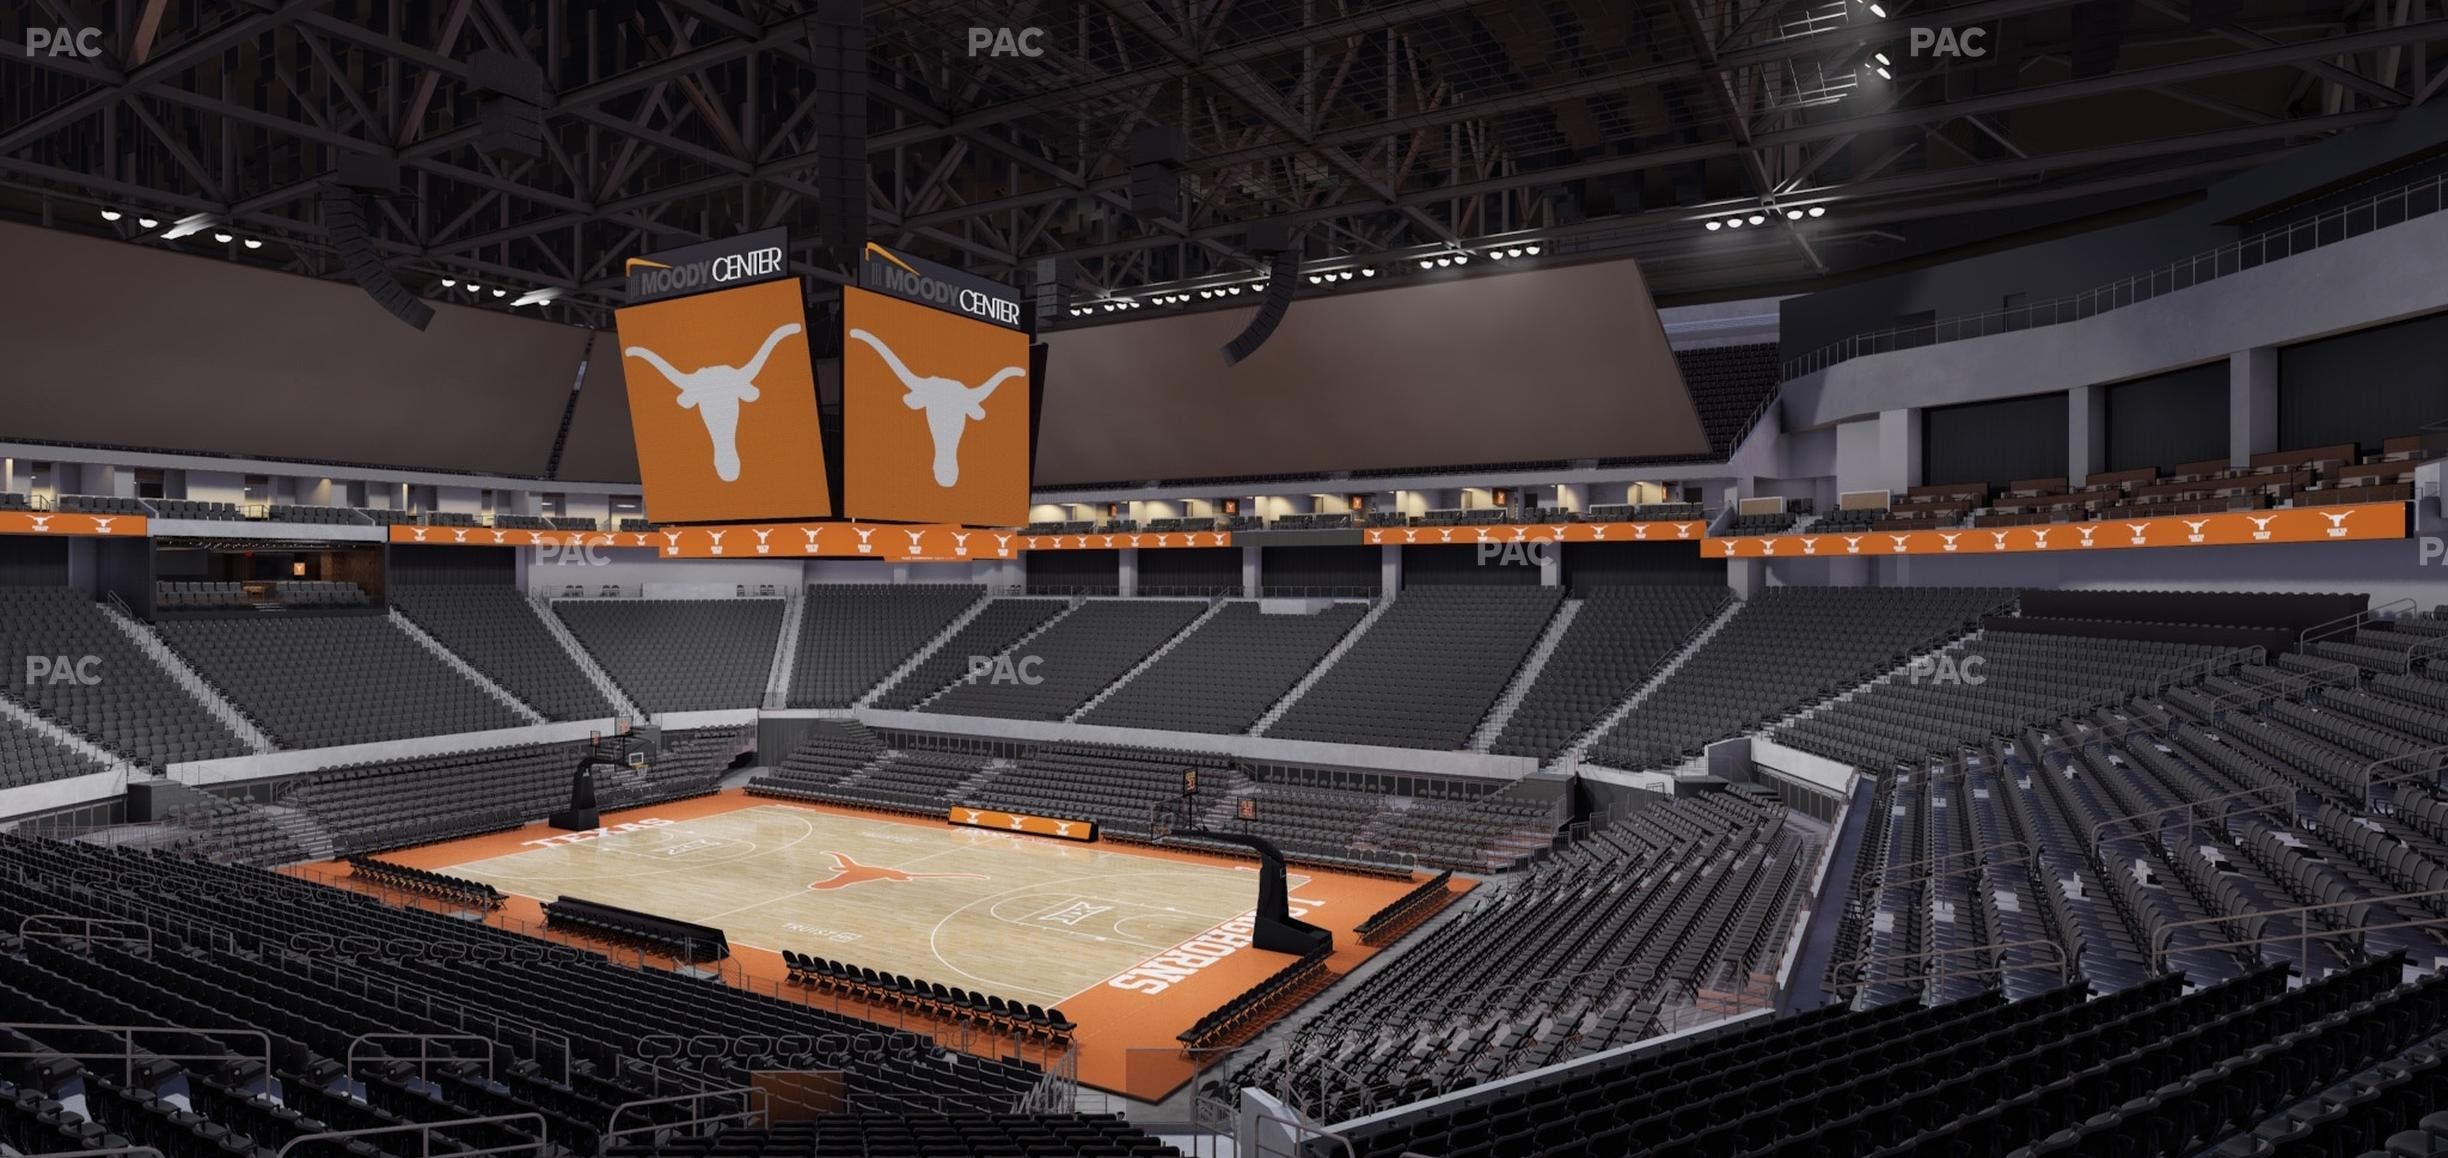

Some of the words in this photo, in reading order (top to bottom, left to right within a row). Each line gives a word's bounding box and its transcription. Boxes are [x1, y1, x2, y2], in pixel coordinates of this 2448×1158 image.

[641, 260, 711, 295] MOODY
[712, 247, 783, 282] CENTER
[885, 265, 960, 307] MOODY
[959, 288, 1020, 325] CENTER
[520, 817, 675, 849] TEXAS
